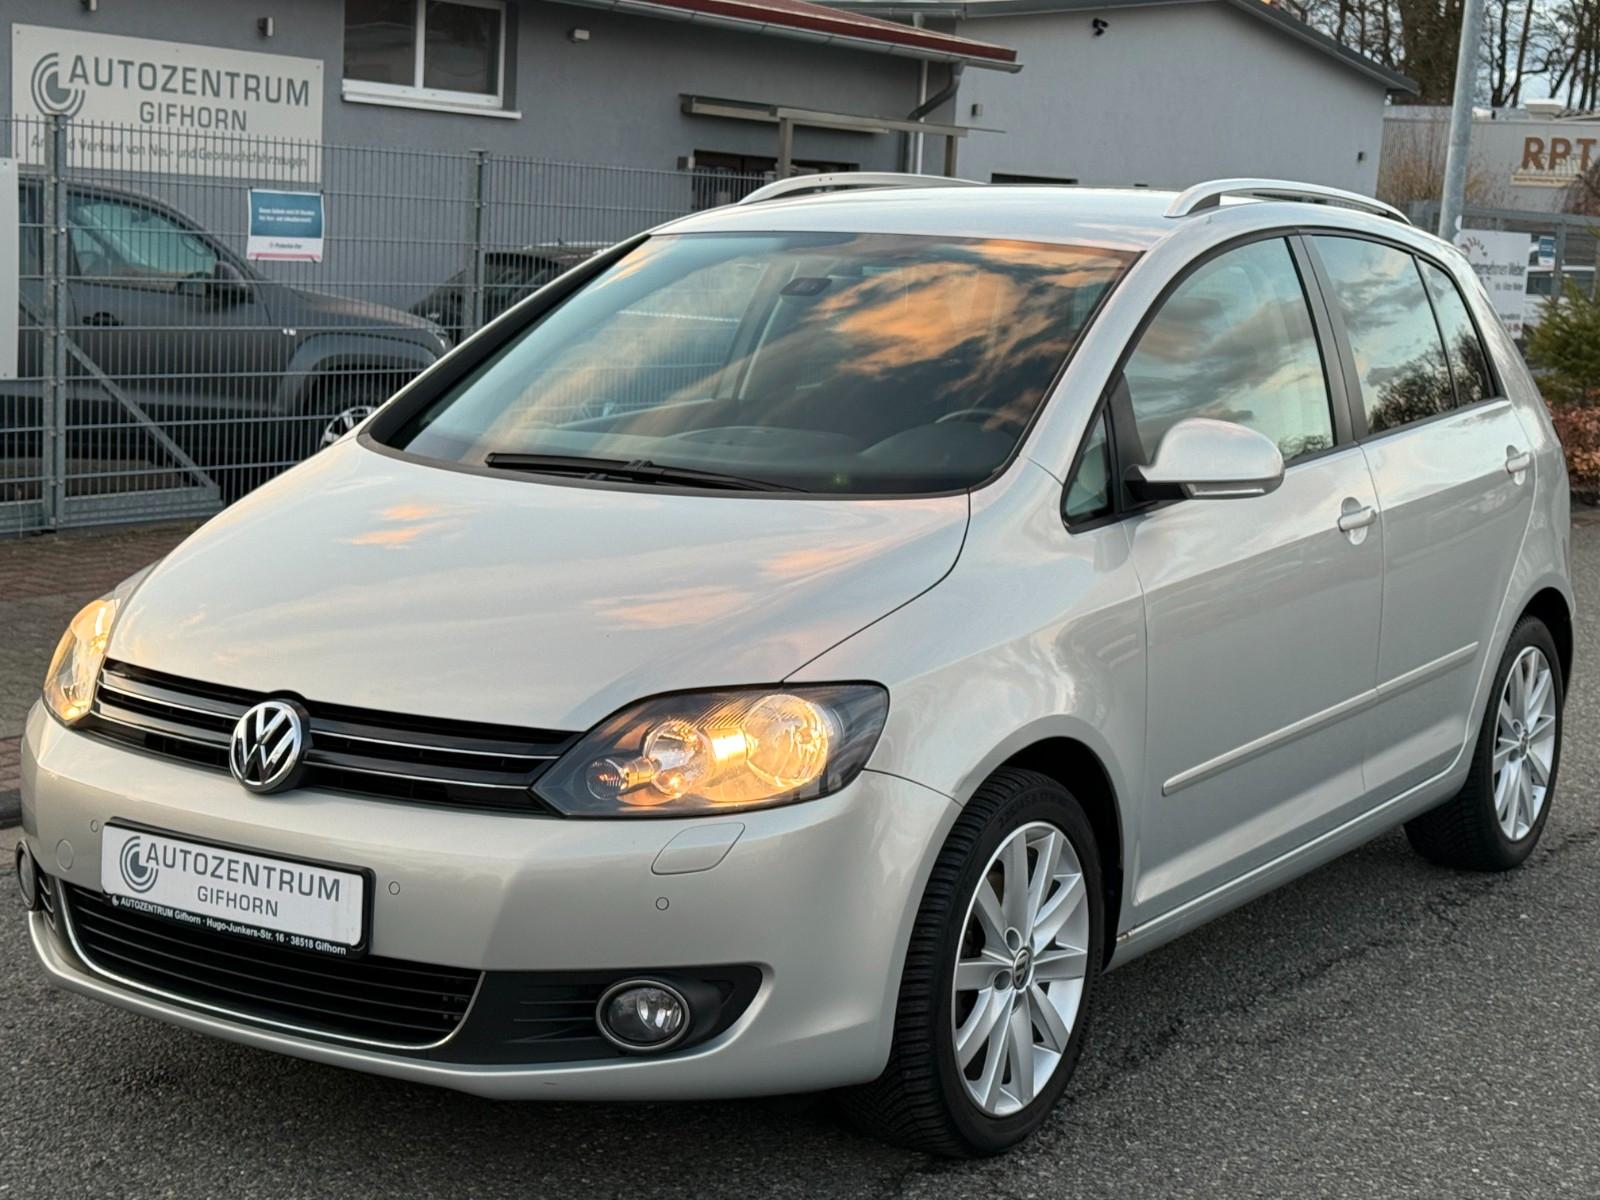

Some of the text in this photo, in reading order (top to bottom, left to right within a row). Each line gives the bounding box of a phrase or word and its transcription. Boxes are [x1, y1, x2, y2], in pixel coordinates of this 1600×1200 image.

[68, 54, 310, 107] AUTOZENTRUM
[139, 101, 248, 132] GIFHORN
[1521, 135, 1597, 172] RPT
[145, 842, 341, 902] AUTOZENTRUM
[197, 885, 279, 918] GIFHORN
[120, 897, 347, 956] AUTOZENTRUM Gifhorn Hugo-Junkers-Str. 16 38518 Gifhorn
